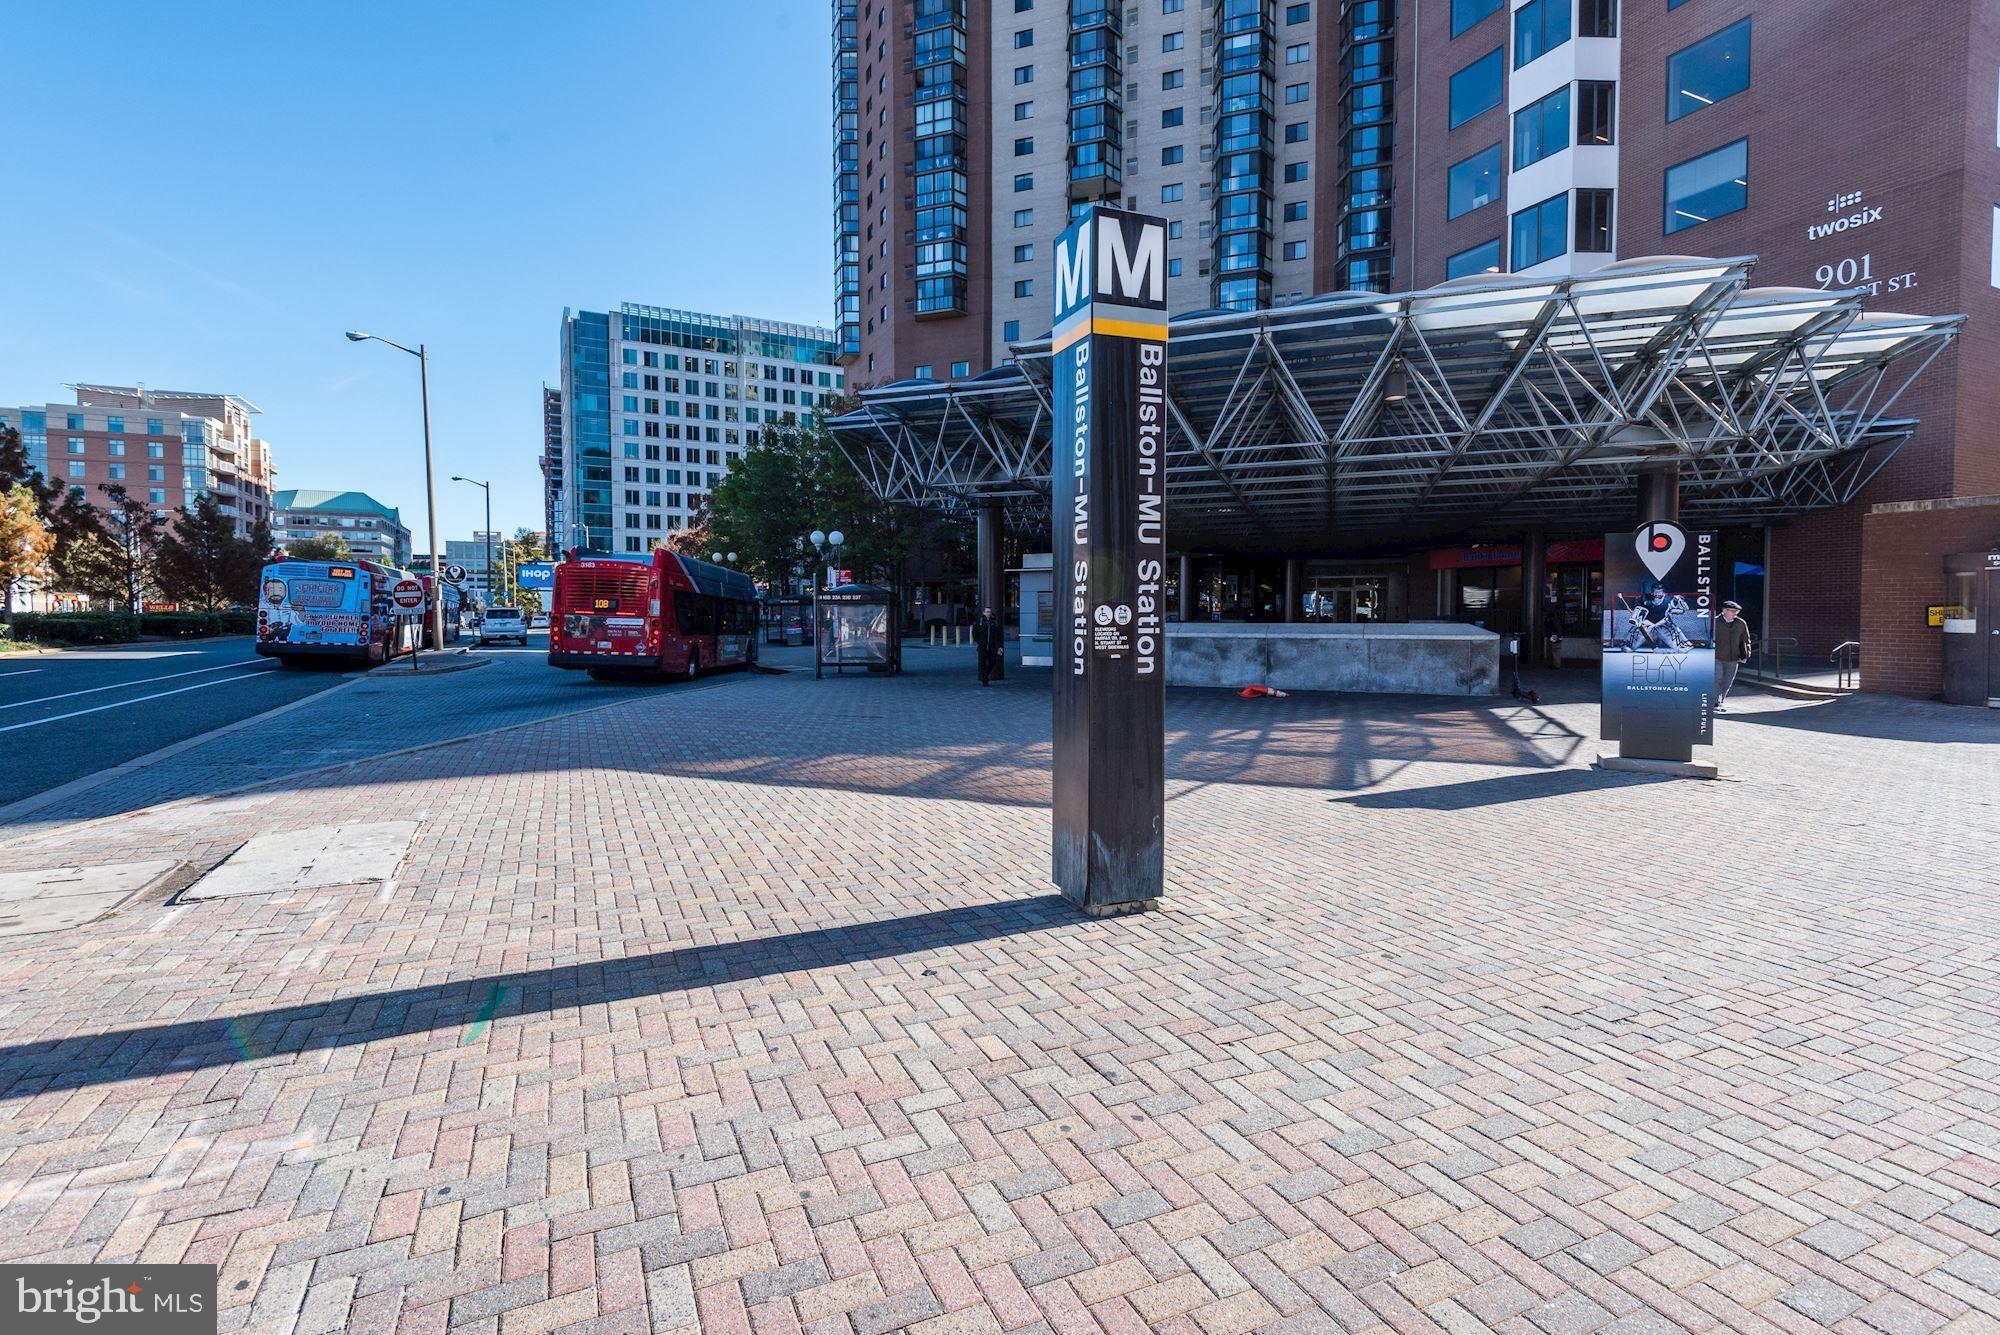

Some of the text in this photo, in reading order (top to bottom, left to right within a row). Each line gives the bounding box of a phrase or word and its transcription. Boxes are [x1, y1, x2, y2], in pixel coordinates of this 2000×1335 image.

[1098, 216, 1164, 302] M
[1807, 206, 1883, 240] twosix
[1055, 220, 1090, 318] M
[1815, 253, 1872, 290] 901
[1074, 560, 1088, 676] Station
[1137, 558, 1162, 674] Station
[1696, 534, 1711, 618] BALLSTON
[1632, 655, 1688, 671] PLAY
[1632, 669, 1687, 684] FULL
